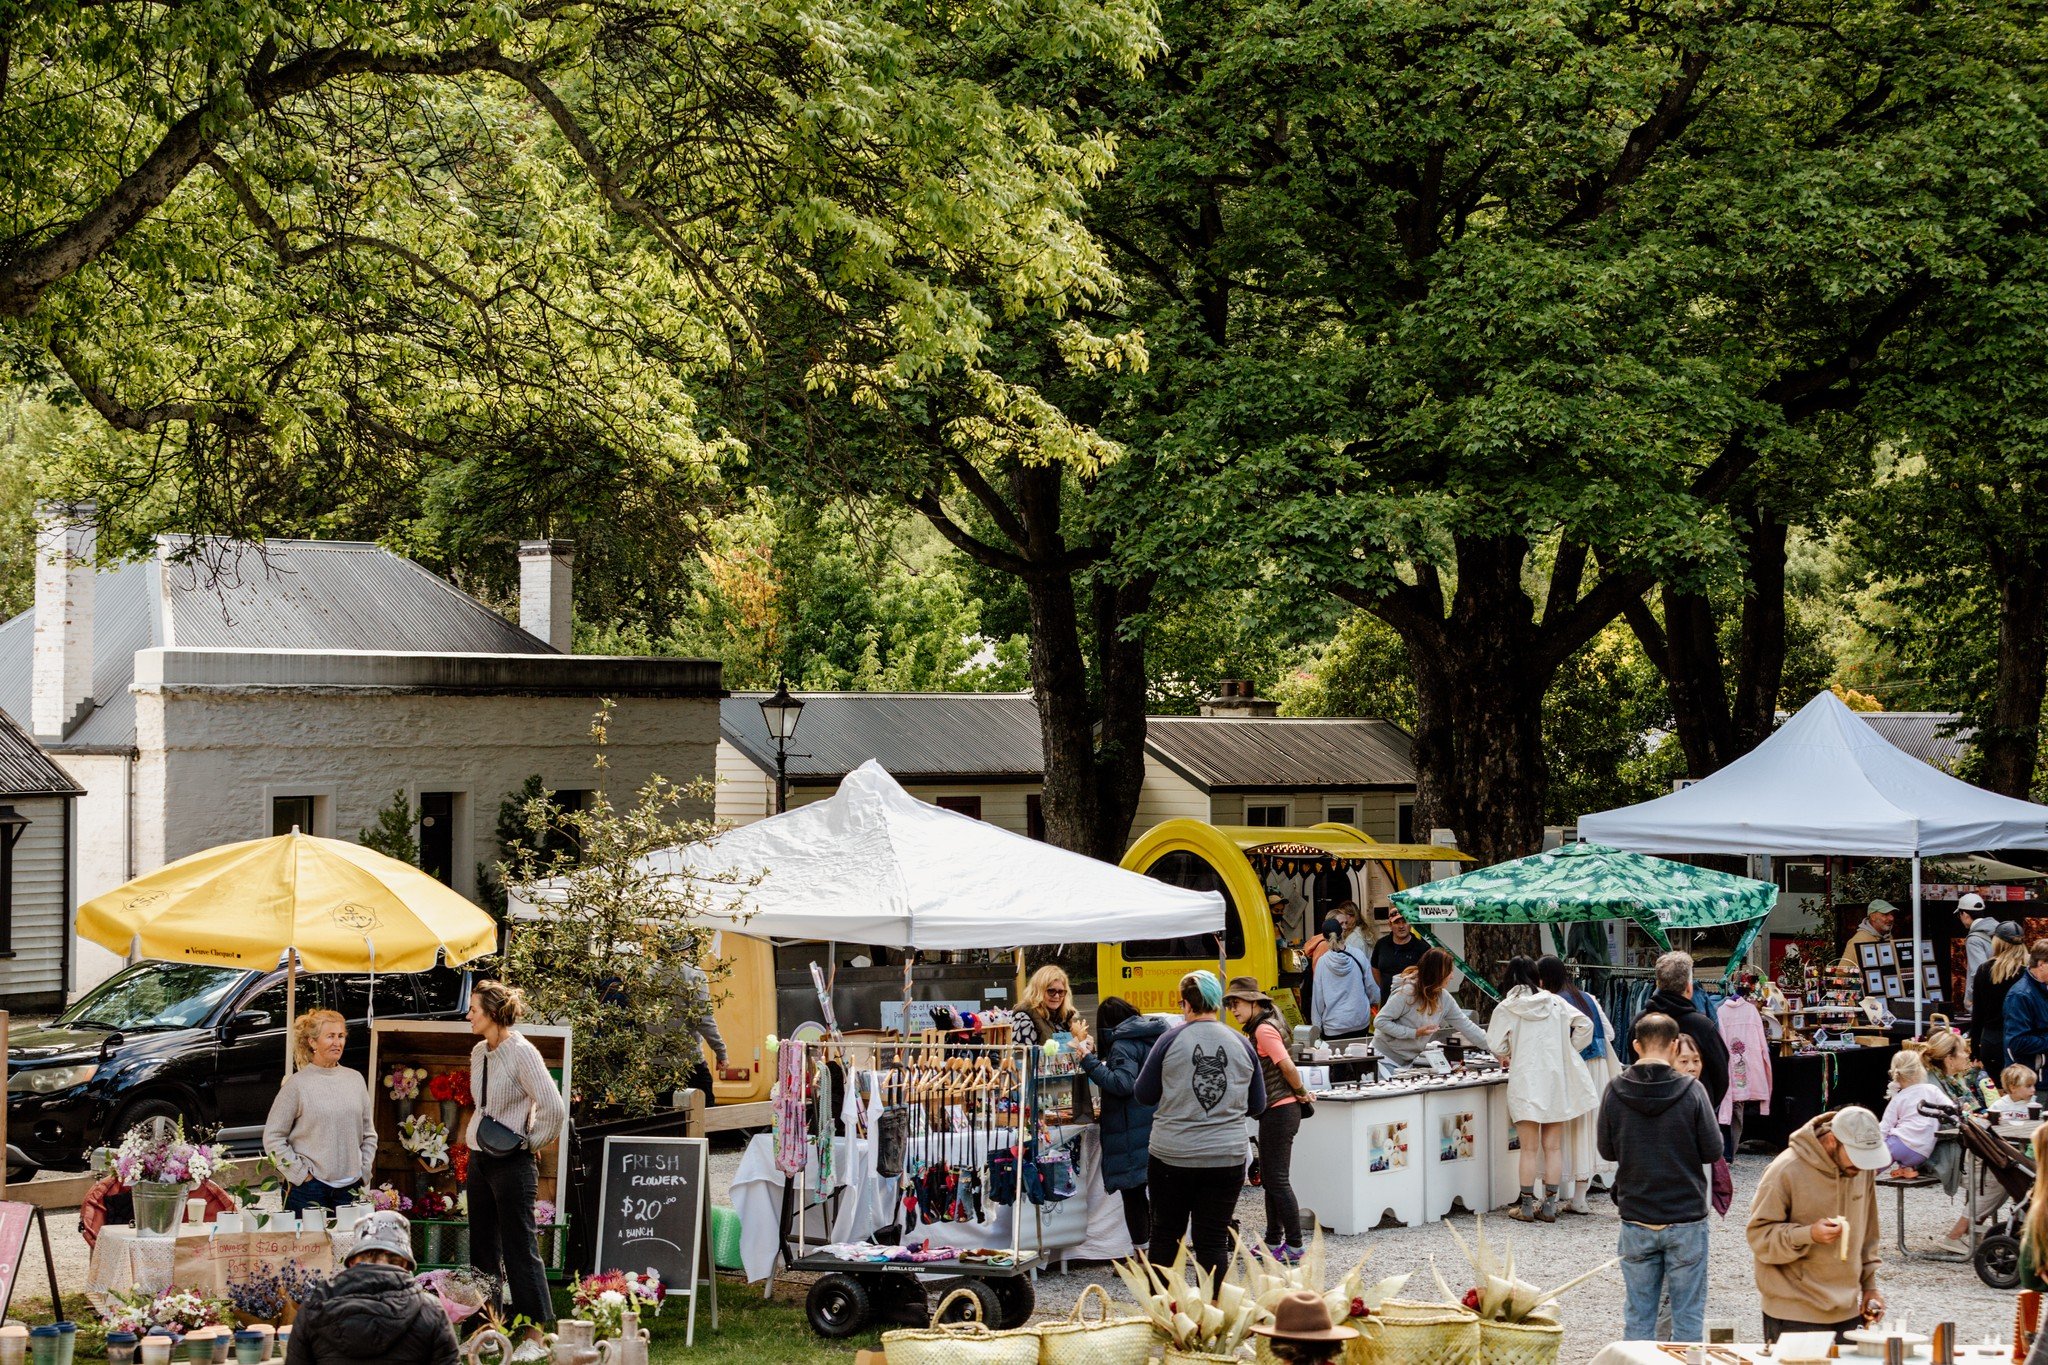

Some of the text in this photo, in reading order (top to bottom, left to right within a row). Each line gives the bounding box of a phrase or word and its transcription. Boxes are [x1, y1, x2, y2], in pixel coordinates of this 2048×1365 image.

[191, 947, 209, 956] Veuve
[623, 1154, 679, 1173] FRESH
[626, 1227, 654, 1237] BUNCH
